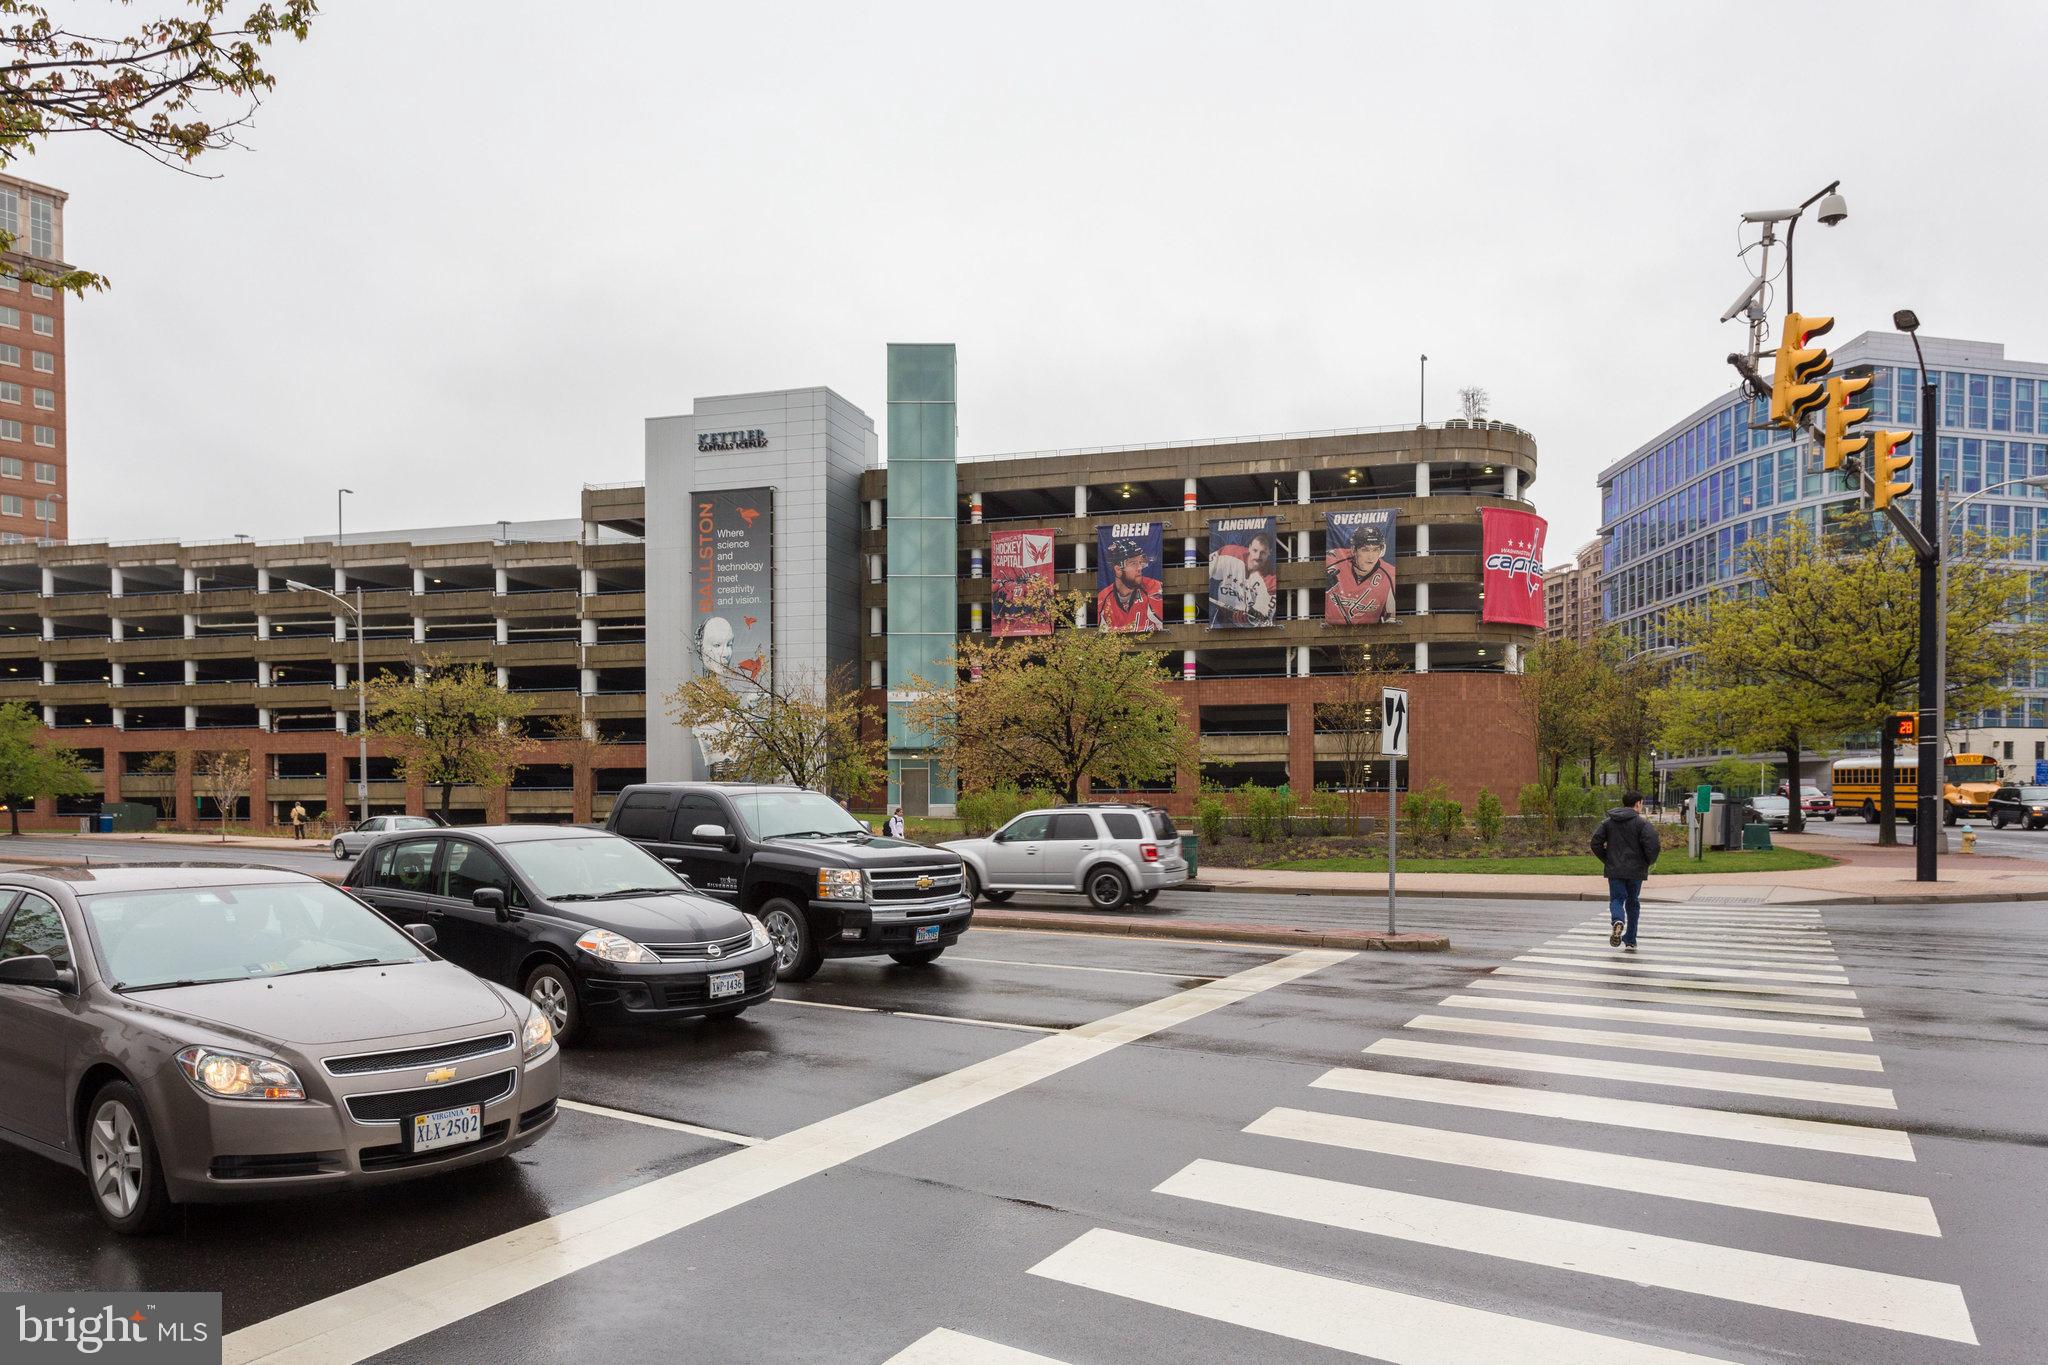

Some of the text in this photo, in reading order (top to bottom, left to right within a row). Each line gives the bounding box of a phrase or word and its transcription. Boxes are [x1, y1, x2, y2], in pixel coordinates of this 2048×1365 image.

[698, 429, 765, 445] KETTLER
[698, 437, 769, 453] CAPITALS ICEPLEX
[1217, 518, 1267, 532] LANGWAY
[1333, 512, 1389, 525] OVECHKIN
[717, 529, 744, 538] Where
[1111, 523, 1150, 538] GREEN
[717, 540, 750, 550] science
[995, 540, 1022, 555] HOCKEY
[699, 503, 714, 613] BALLSTON
[717, 552, 733, 561] and
[995, 555, 1022, 567] CAPITAL
[717, 561, 764, 572] technology
[717, 574, 739, 583] meet
[717, 584, 755, 595] creativity
[717, 596, 762, 605] and vision.
[1899, 721, 1913, 734] 28
[712, 979, 742, 993] XWP-1436
[431, 1109, 464, 1121] VIRGINIA
[416, 1115, 478, 1143] XLX-2502
